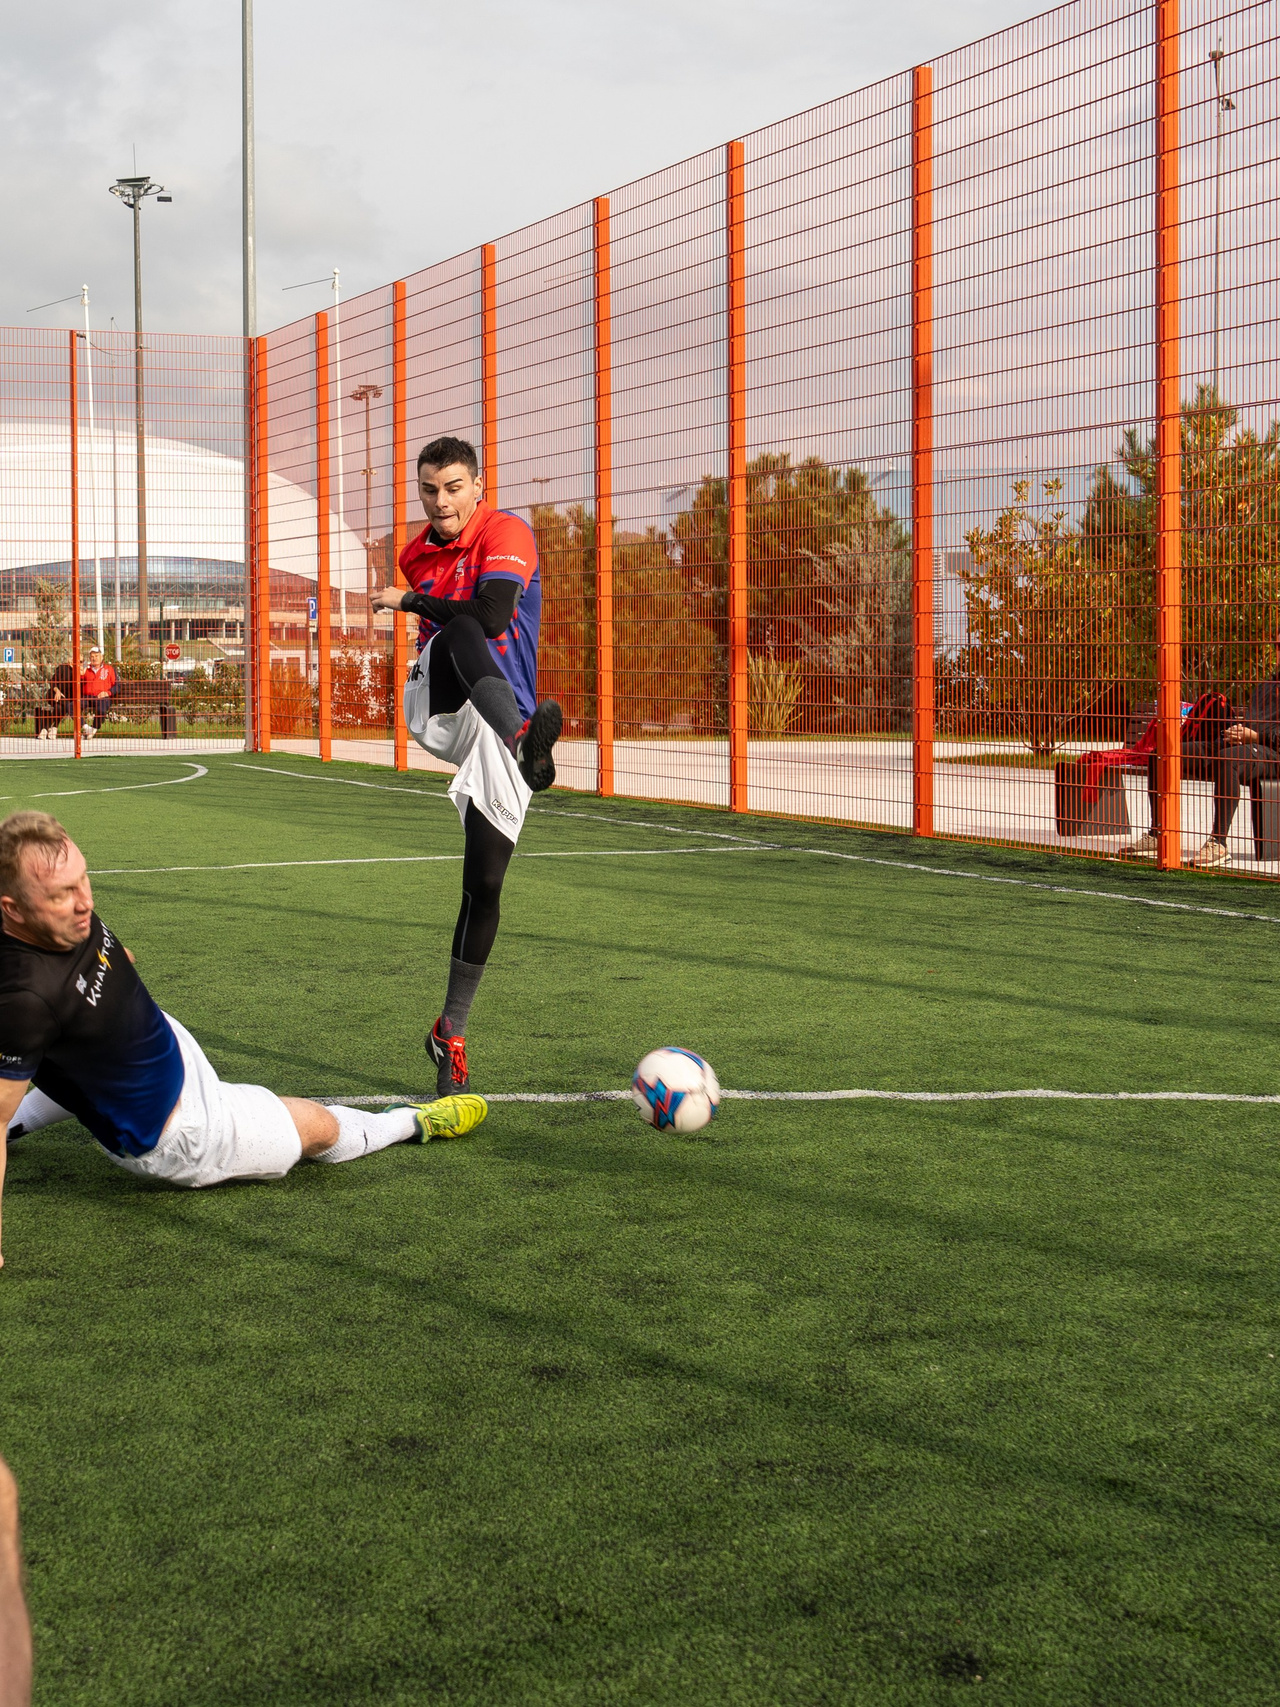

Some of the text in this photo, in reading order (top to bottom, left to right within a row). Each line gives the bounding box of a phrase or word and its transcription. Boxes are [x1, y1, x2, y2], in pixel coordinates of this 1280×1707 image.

[309, 600, 316, 618] P
[6, 649, 13, 662] P
[165, 648, 180, 656] STOP
[491, 798, 519, 825] Kappa
